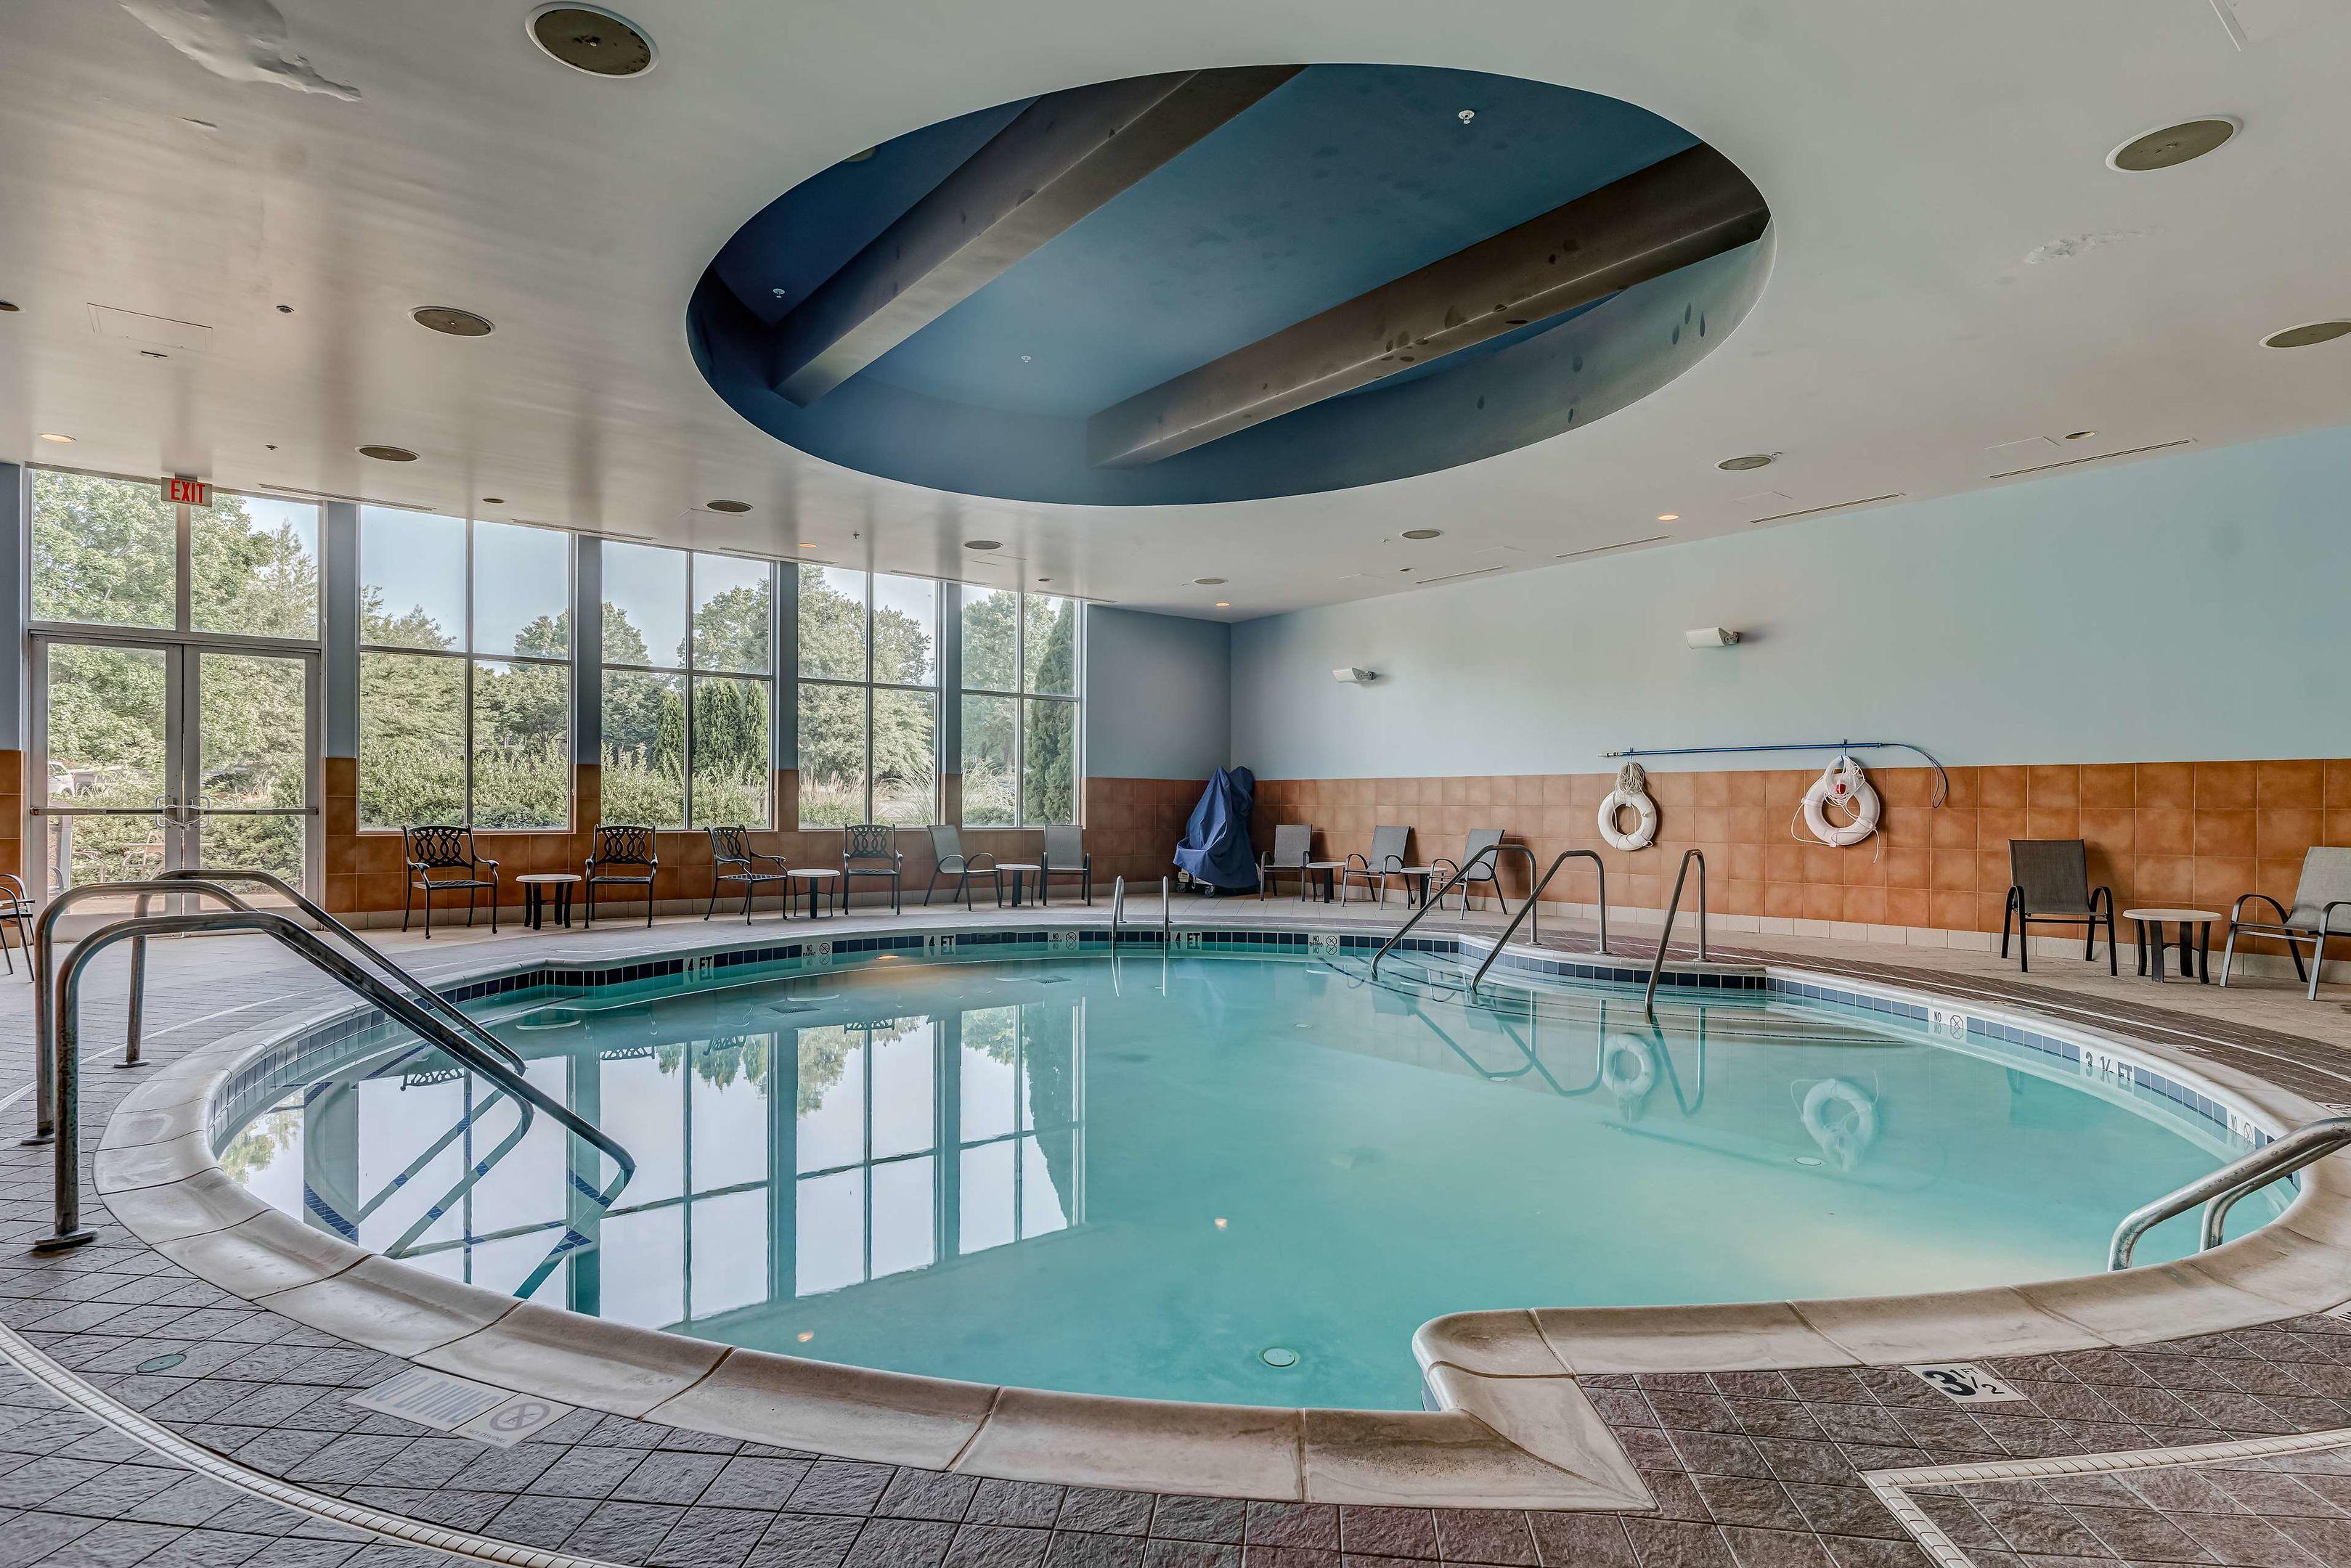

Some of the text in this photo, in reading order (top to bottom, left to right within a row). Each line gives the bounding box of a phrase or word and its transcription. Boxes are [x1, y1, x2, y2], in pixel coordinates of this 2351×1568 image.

[171, 479, 205, 504] EXIT
[929, 935, 954, 946] 4 FT
[1176, 932, 1200, 942] 4 FT
[687, 955, 713, 971] 4 FT
[1934, 1011, 1941, 1022] NO
[2117, 1061, 2132, 1082] FT
[358, 1371, 500, 1424] NO DIVING
